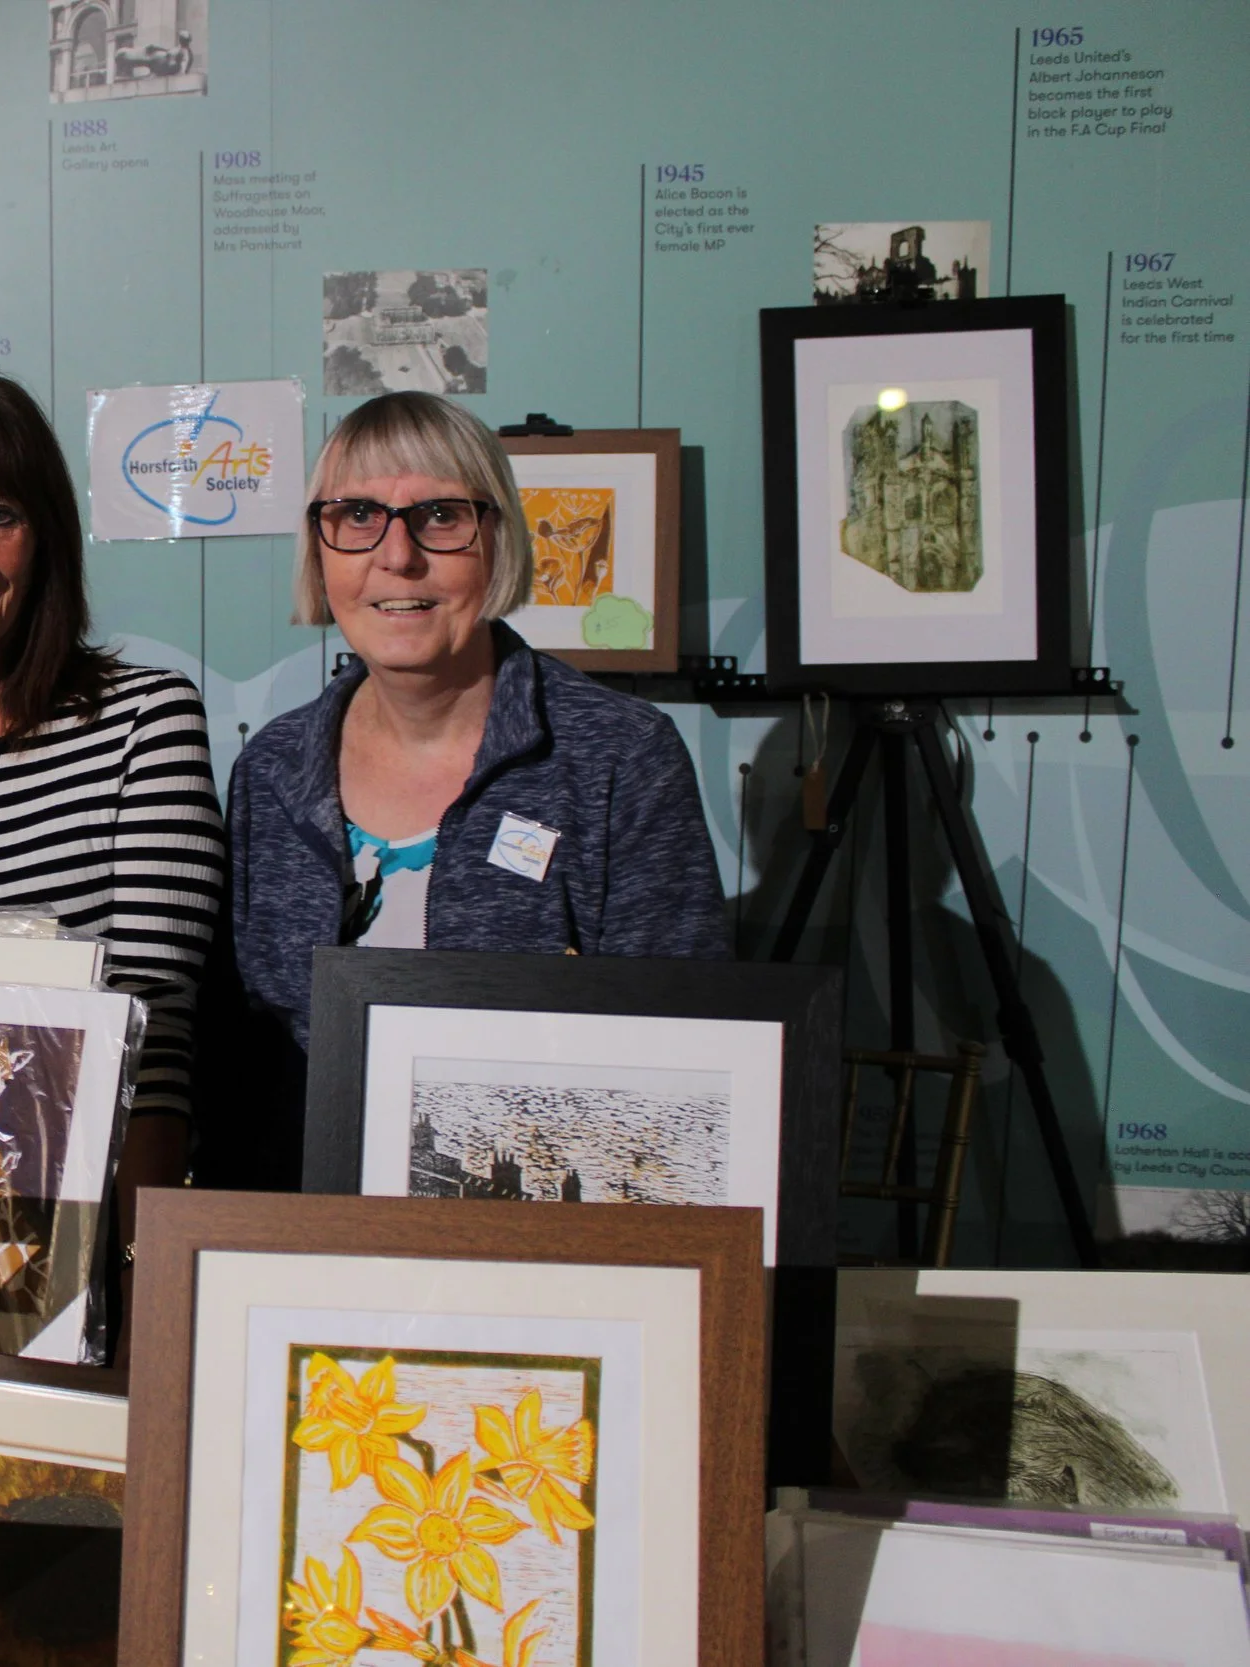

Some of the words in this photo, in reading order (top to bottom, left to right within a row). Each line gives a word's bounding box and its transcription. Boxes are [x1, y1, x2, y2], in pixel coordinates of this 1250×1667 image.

[1032, 27, 1084, 48] 1965
[1030, 52, 1070, 65] Leeds
[1074, 48, 1132, 63] United's
[1029, 71, 1071, 84] Albert
[1075, 69, 1165, 82] Johanneson
[1028, 89, 1092, 102] becomes
[1097, 88, 1120, 99] the
[1124, 86, 1153, 98] first
[1028, 107, 1067, 120] black
[1070, 106, 1118, 122] player
[1121, 106, 1137, 117] to
[1140, 103, 1174, 119] play
[63, 118, 108, 138] 1888
[1027, 126, 1040, 138] in
[1044, 125, 1067, 137] the
[1095, 123, 1126, 138] Cup
[1130, 122, 1166, 134] Final
[62, 142, 96, 154] Leeds
[100, 141, 119, 152] Art
[62, 158, 108, 172] Gallery
[112, 158, 149, 171] opens
[215, 150, 261, 169] 1908
[213, 174, 246, 185] Mass
[249, 172, 300, 186] meeting
[304, 170, 317, 182] of
[656, 163, 704, 183] 1945
[213, 189, 291, 204] Suffragettes
[295, 190, 311, 200] on
[655, 188, 687, 200] Alice
[691, 187, 733, 200] Bacon
[737, 186, 748, 199] is
[214, 206, 288, 218] Woodhouse
[292, 204, 326, 217] Moor,
[655, 206, 704, 217] elected
[708, 208, 724, 217] as
[727, 205, 750, 216] the
[213, 223, 279, 236] addressed
[283, 221, 299, 236] by
[655, 222, 694, 238] City's
[697, 222, 723, 234] first
[727, 224, 755, 233] ever
[214, 240, 236, 251] Mrs
[240, 239, 302, 251] Pankhurst
[655, 240, 701, 252] female
[704, 239, 726, 250] MP
[1125, 252, 1178, 272] 1967
[1123, 278, 1163, 290] Leeds
[1167, 277, 1203, 289] West
[1122, 296, 1167, 308] Indian
[1171, 293, 1234, 307] Carnival
[1121, 314, 1133, 326] is
[1136, 312, 1214, 326] celebrated
[1120, 332, 1141, 344] for
[1144, 332, 1167, 343] the
[1171, 331, 1199, 343] first
[1204, 331, 1235, 343] time
[190, 441, 272, 487] Arts
[206, 476, 261, 492] Society
[1117, 1123, 1168, 1140] 1968
[1115, 1145, 1179, 1157] Lotherton
[1183, 1147, 1210, 1158] Hall
[1213, 1148, 1224, 1159] is
[1114, 1162, 1132, 1175] by
[1135, 1162, 1174, 1174] Leeds
[1177, 1162, 1207, 1178] City
